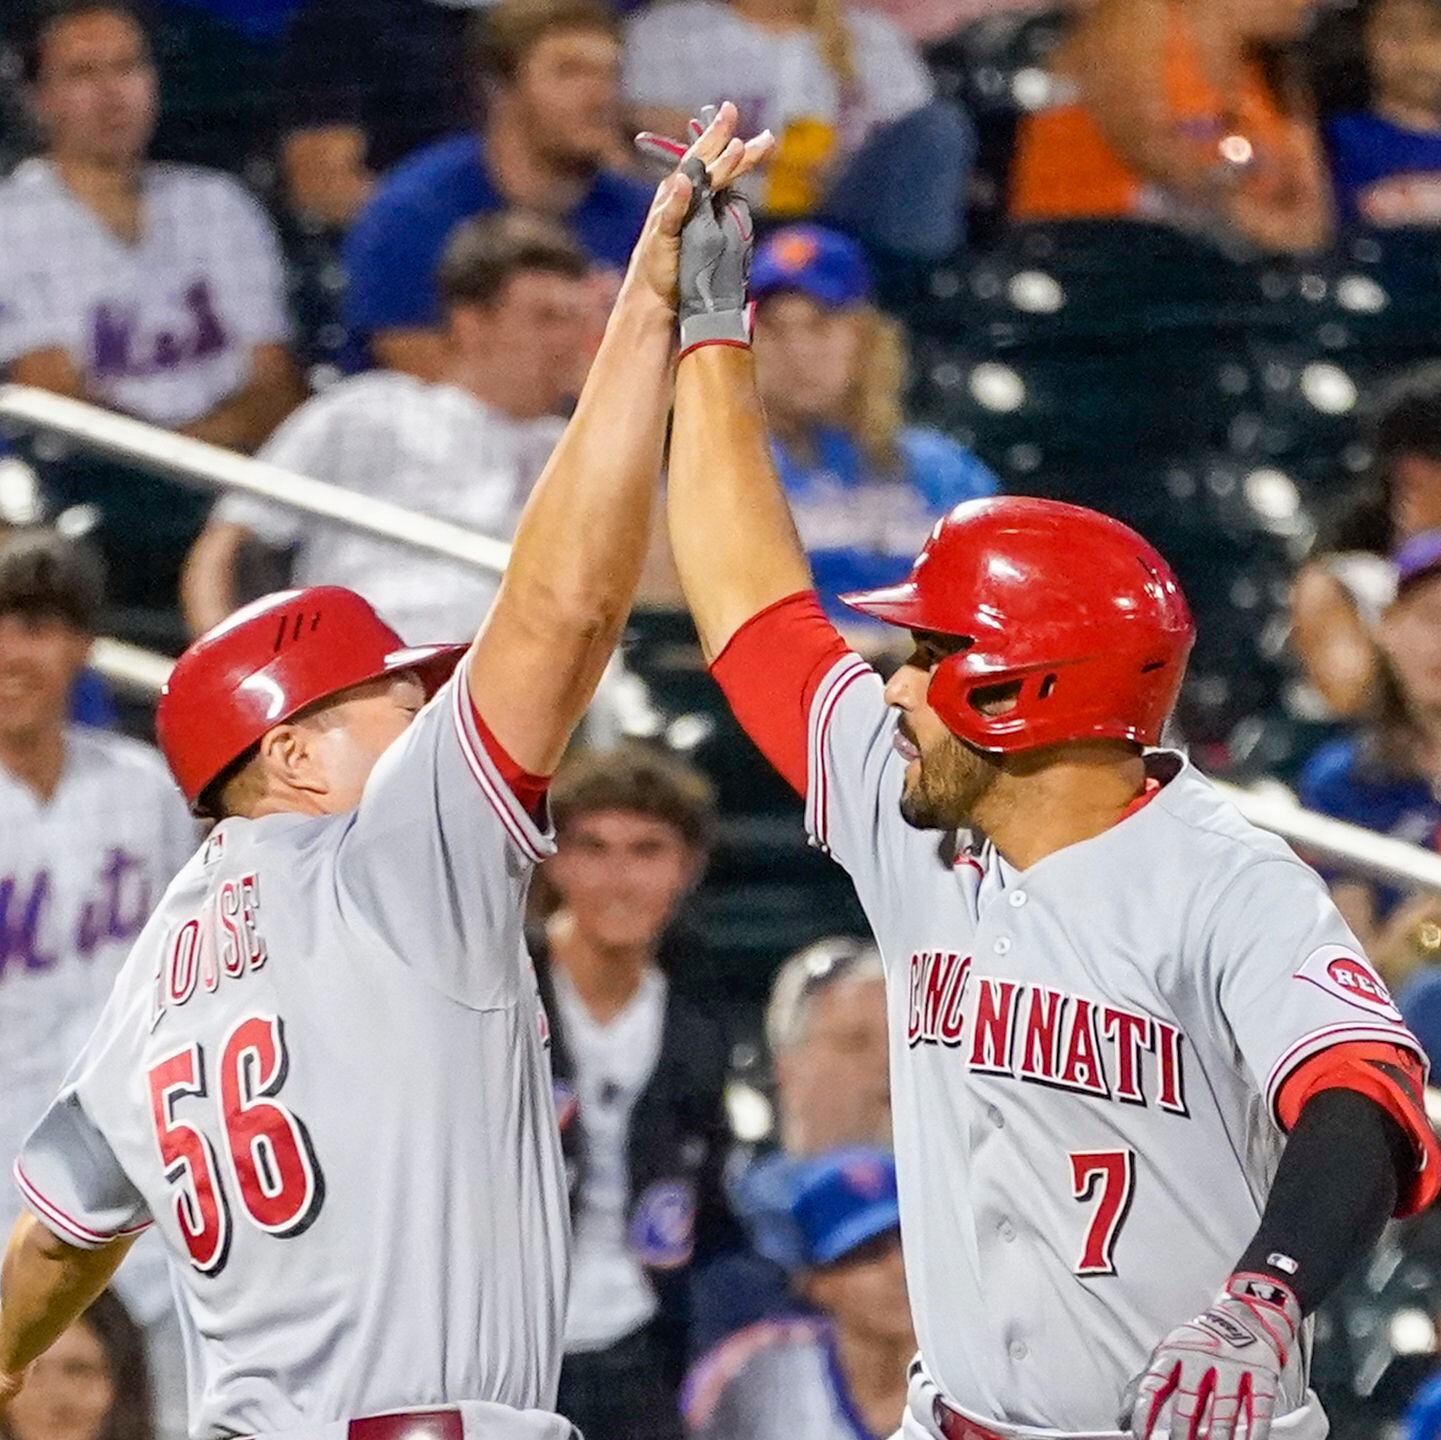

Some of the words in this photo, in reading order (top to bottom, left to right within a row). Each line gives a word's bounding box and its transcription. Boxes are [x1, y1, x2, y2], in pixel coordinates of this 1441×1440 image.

[906, 948, 1189, 1117] CINCNNATI
[146, 1013, 326, 1278] 56
[1069, 1149, 1134, 1275] 7
